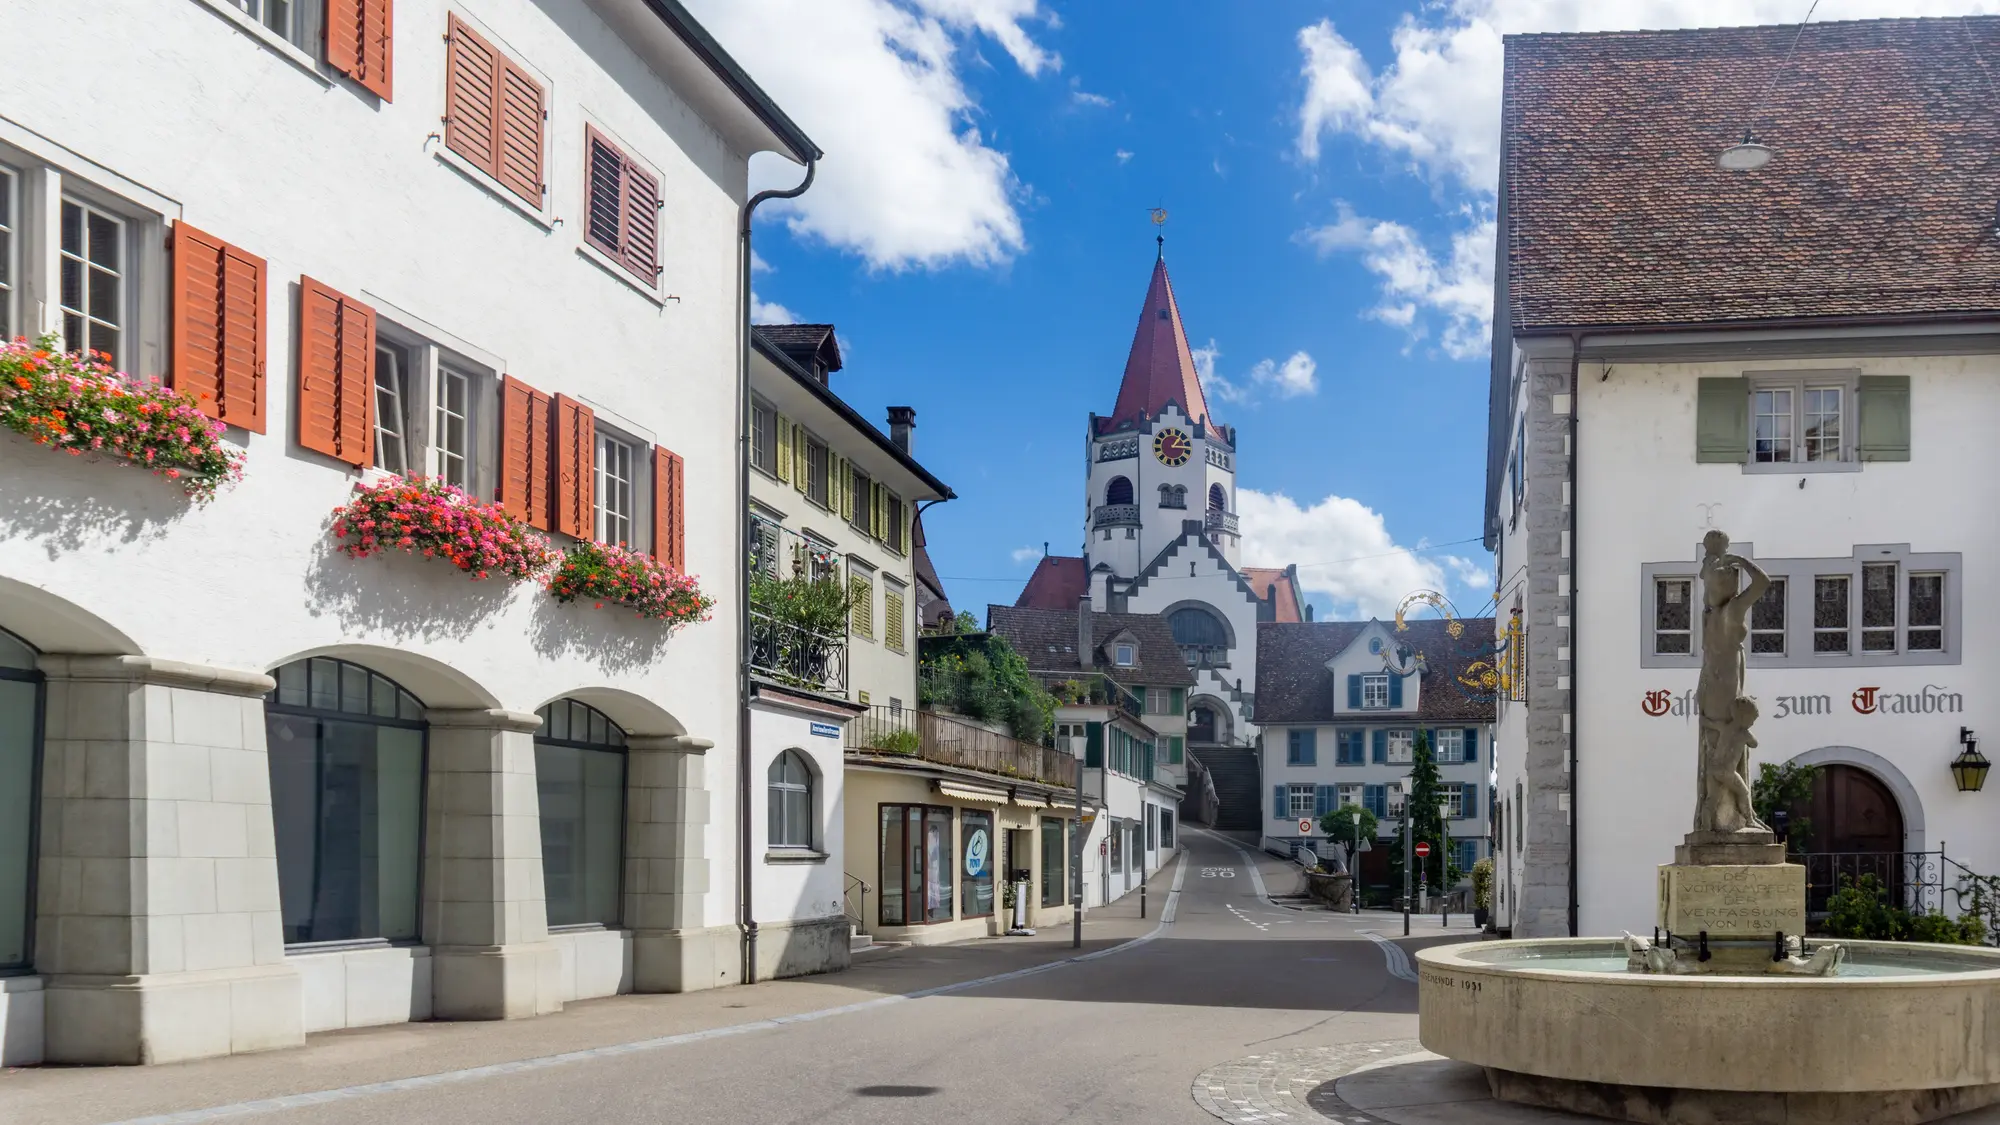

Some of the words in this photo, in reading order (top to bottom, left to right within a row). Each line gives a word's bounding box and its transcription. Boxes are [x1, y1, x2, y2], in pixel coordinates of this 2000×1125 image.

[1773, 694, 1832, 719] zum
[1852, 684, 1964, 715] Trauben
[1724, 896, 1758, 906] DER
[1682, 908, 1799, 918] VERFASSUNG
[1703, 919, 1737, 929] VON
